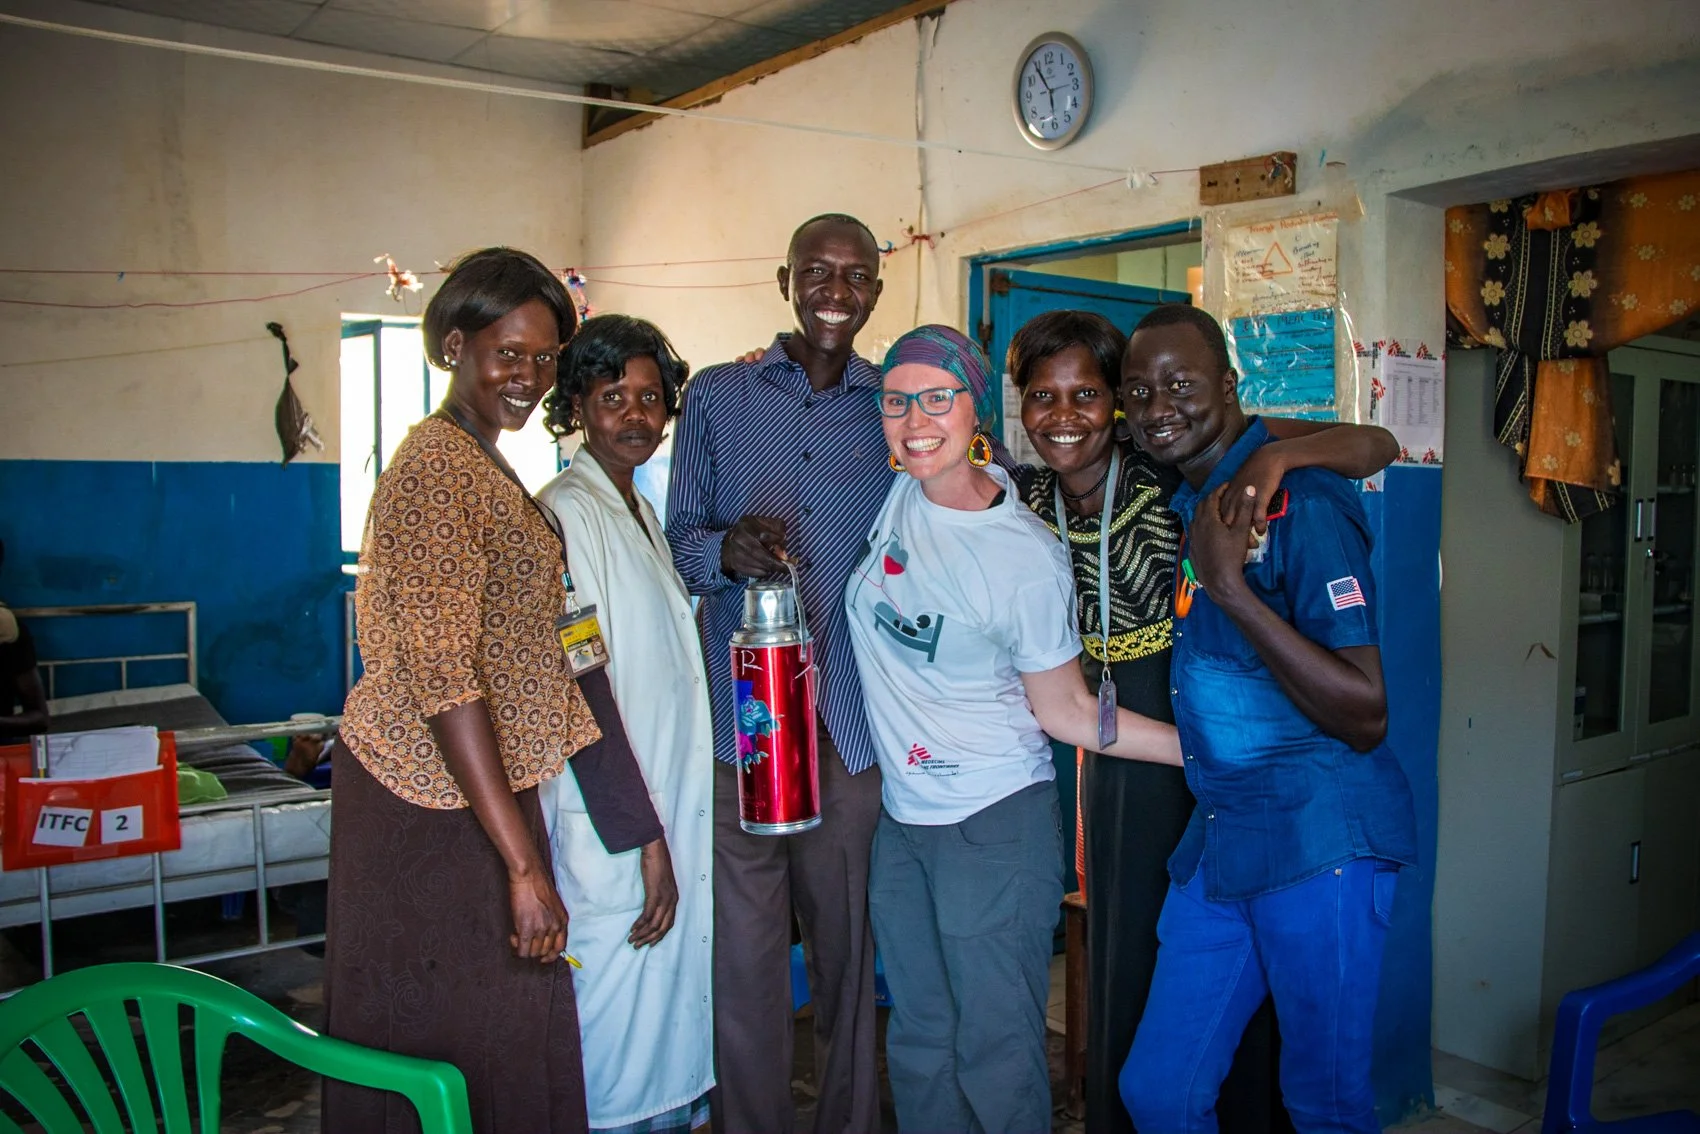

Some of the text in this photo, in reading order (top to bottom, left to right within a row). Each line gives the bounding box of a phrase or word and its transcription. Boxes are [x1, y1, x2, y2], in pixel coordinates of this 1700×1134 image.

[1044, 51, 1053, 65] 12
[1060, 53, 1064, 65] 1
[1067, 62, 1075, 76] 2
[1027, 75, 1036, 87] 10
[1072, 78, 1079, 90] 3
[1026, 91, 1032, 103] 9
[1071, 96, 1078, 108] 4
[1031, 107, 1037, 119] 8
[1064, 111, 1071, 122] 5
[1051, 118, 1058, 130] 6
[39, 813, 89, 832] ITFC
[116, 815, 128, 831] 2
